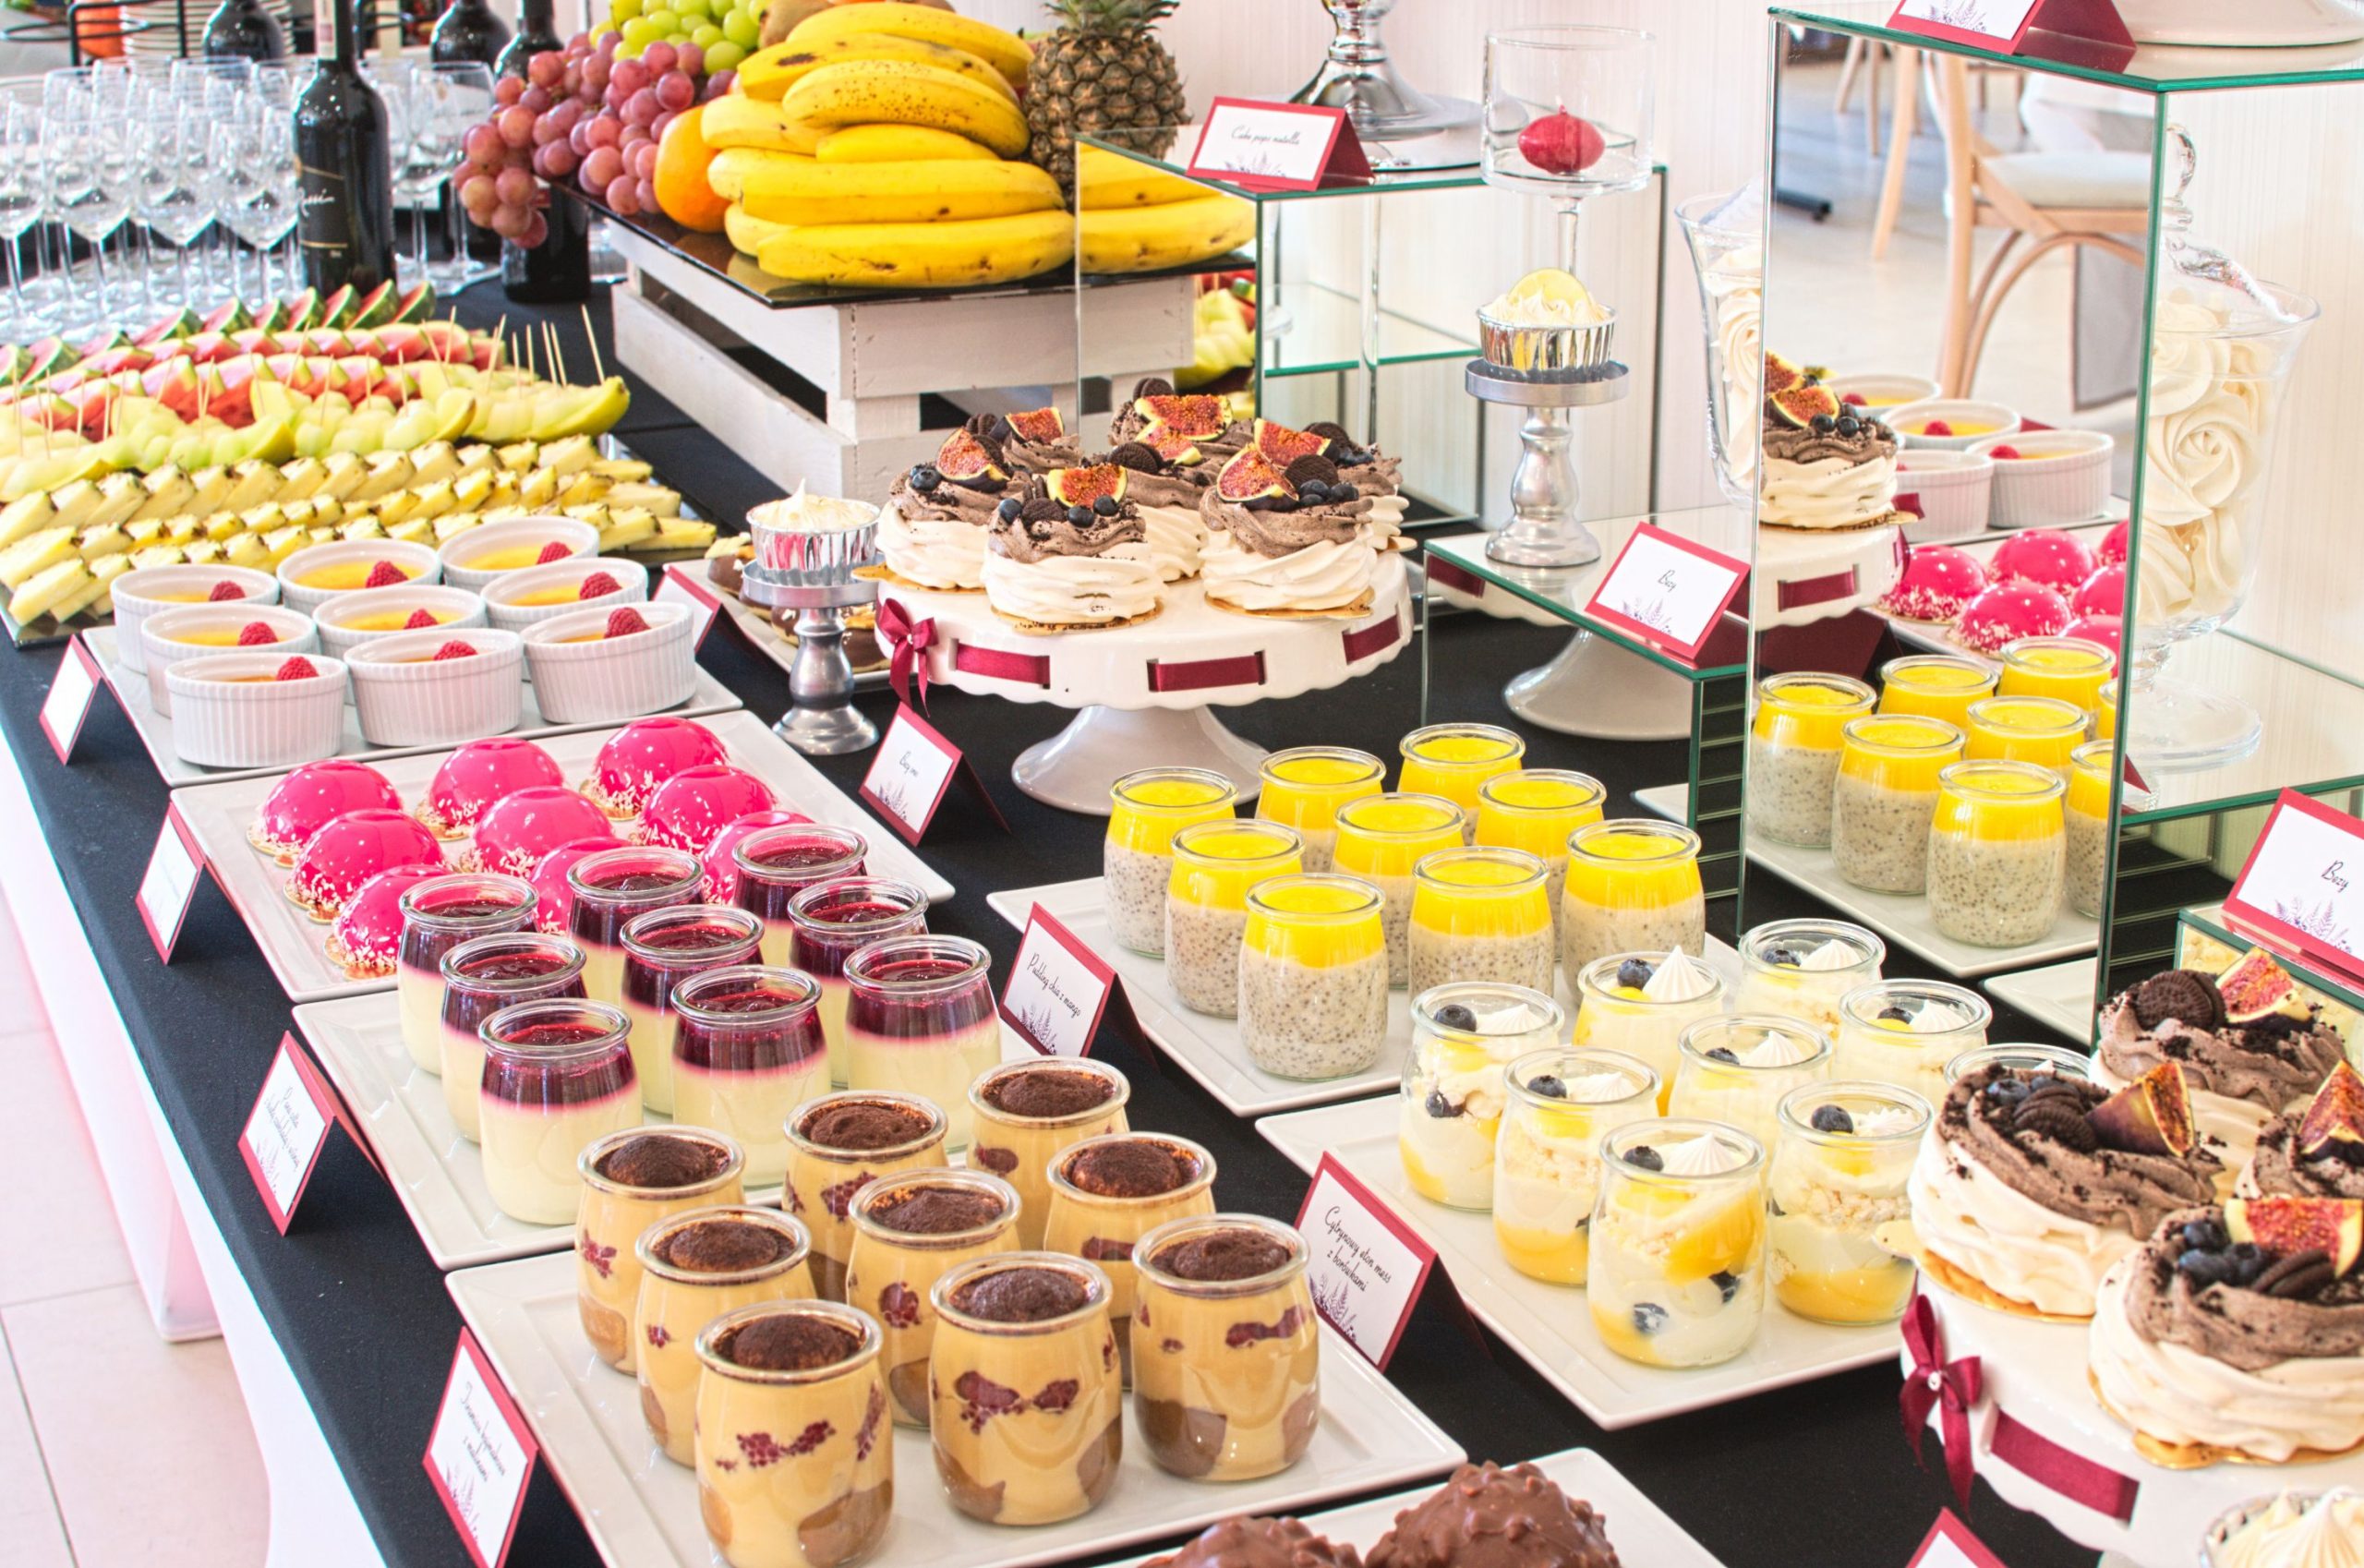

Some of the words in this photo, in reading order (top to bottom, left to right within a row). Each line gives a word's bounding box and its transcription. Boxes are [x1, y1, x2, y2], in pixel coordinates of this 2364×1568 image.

[2321, 860, 2350, 894] Bezy
[1026, 952, 1050, 991] Pudding
[1048, 975, 1061, 997] chia
[1063, 997, 1081, 1019] mango
[1324, 1205, 1360, 1259] Cytrynowy
[1358, 1248, 1375, 1269] eton
[1373, 1263, 1393, 1285] mess
[1326, 1249, 1334, 1259] z
[1332, 1244, 1369, 1293] borówkami
